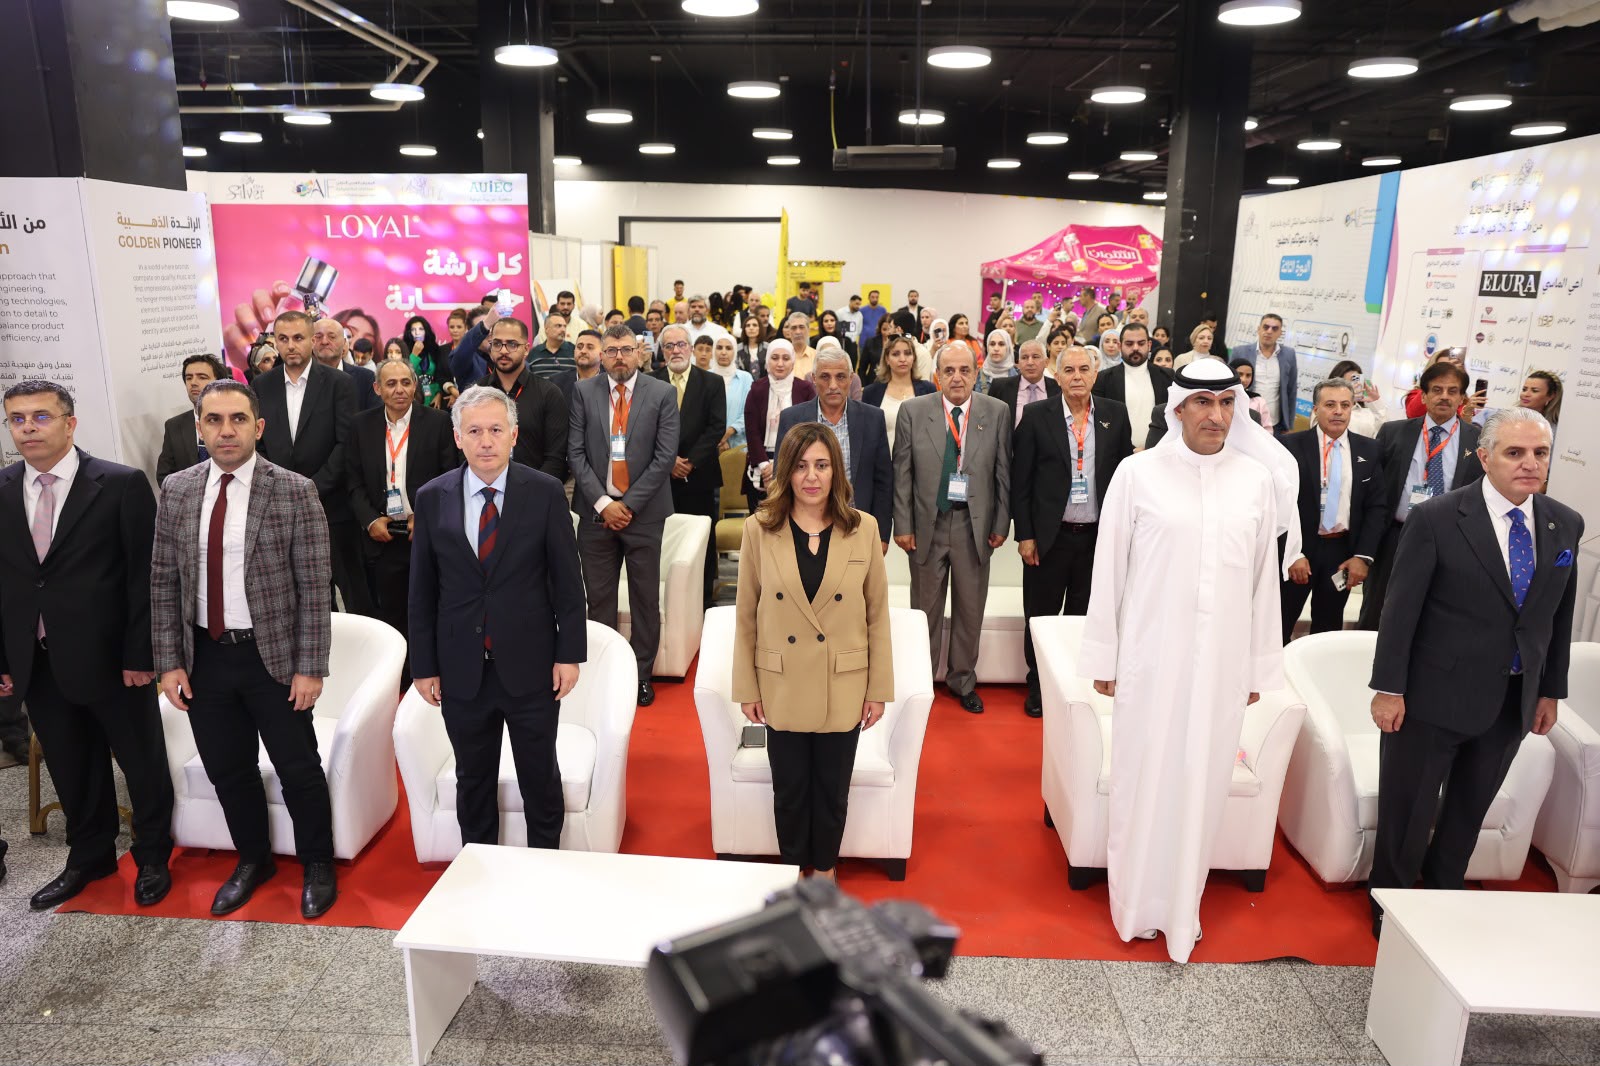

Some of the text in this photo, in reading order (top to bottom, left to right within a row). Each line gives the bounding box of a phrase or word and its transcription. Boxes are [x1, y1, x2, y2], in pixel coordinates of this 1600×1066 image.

[23, 217, 46, 233] من
[117, 212, 168, 229] الذهبية
[324, 214, 420, 239] LOYAL
[118, 235, 202, 249] GOLDEN PIONEER
[423, 249, 522, 283] كل رشة
[39, 273, 56, 281] that
[0, 286, 46, 294] ngineering,
[1482, 274, 1537, 297] ELURA
[11, 297, 68, 306] technologies,
[13, 310, 22, 318] to
[23, 310, 47, 318] detail
[49, 310, 58, 318] to
[31, 322, 65, 331] product
[1, 334, 60, 343] efficiency, and
[11, 361, 35, 369] منهجية
[37, 361, 53, 369] وفق
[55, 361, 72, 369] نعمل
[22, 373, 47, 381] التصنيع
